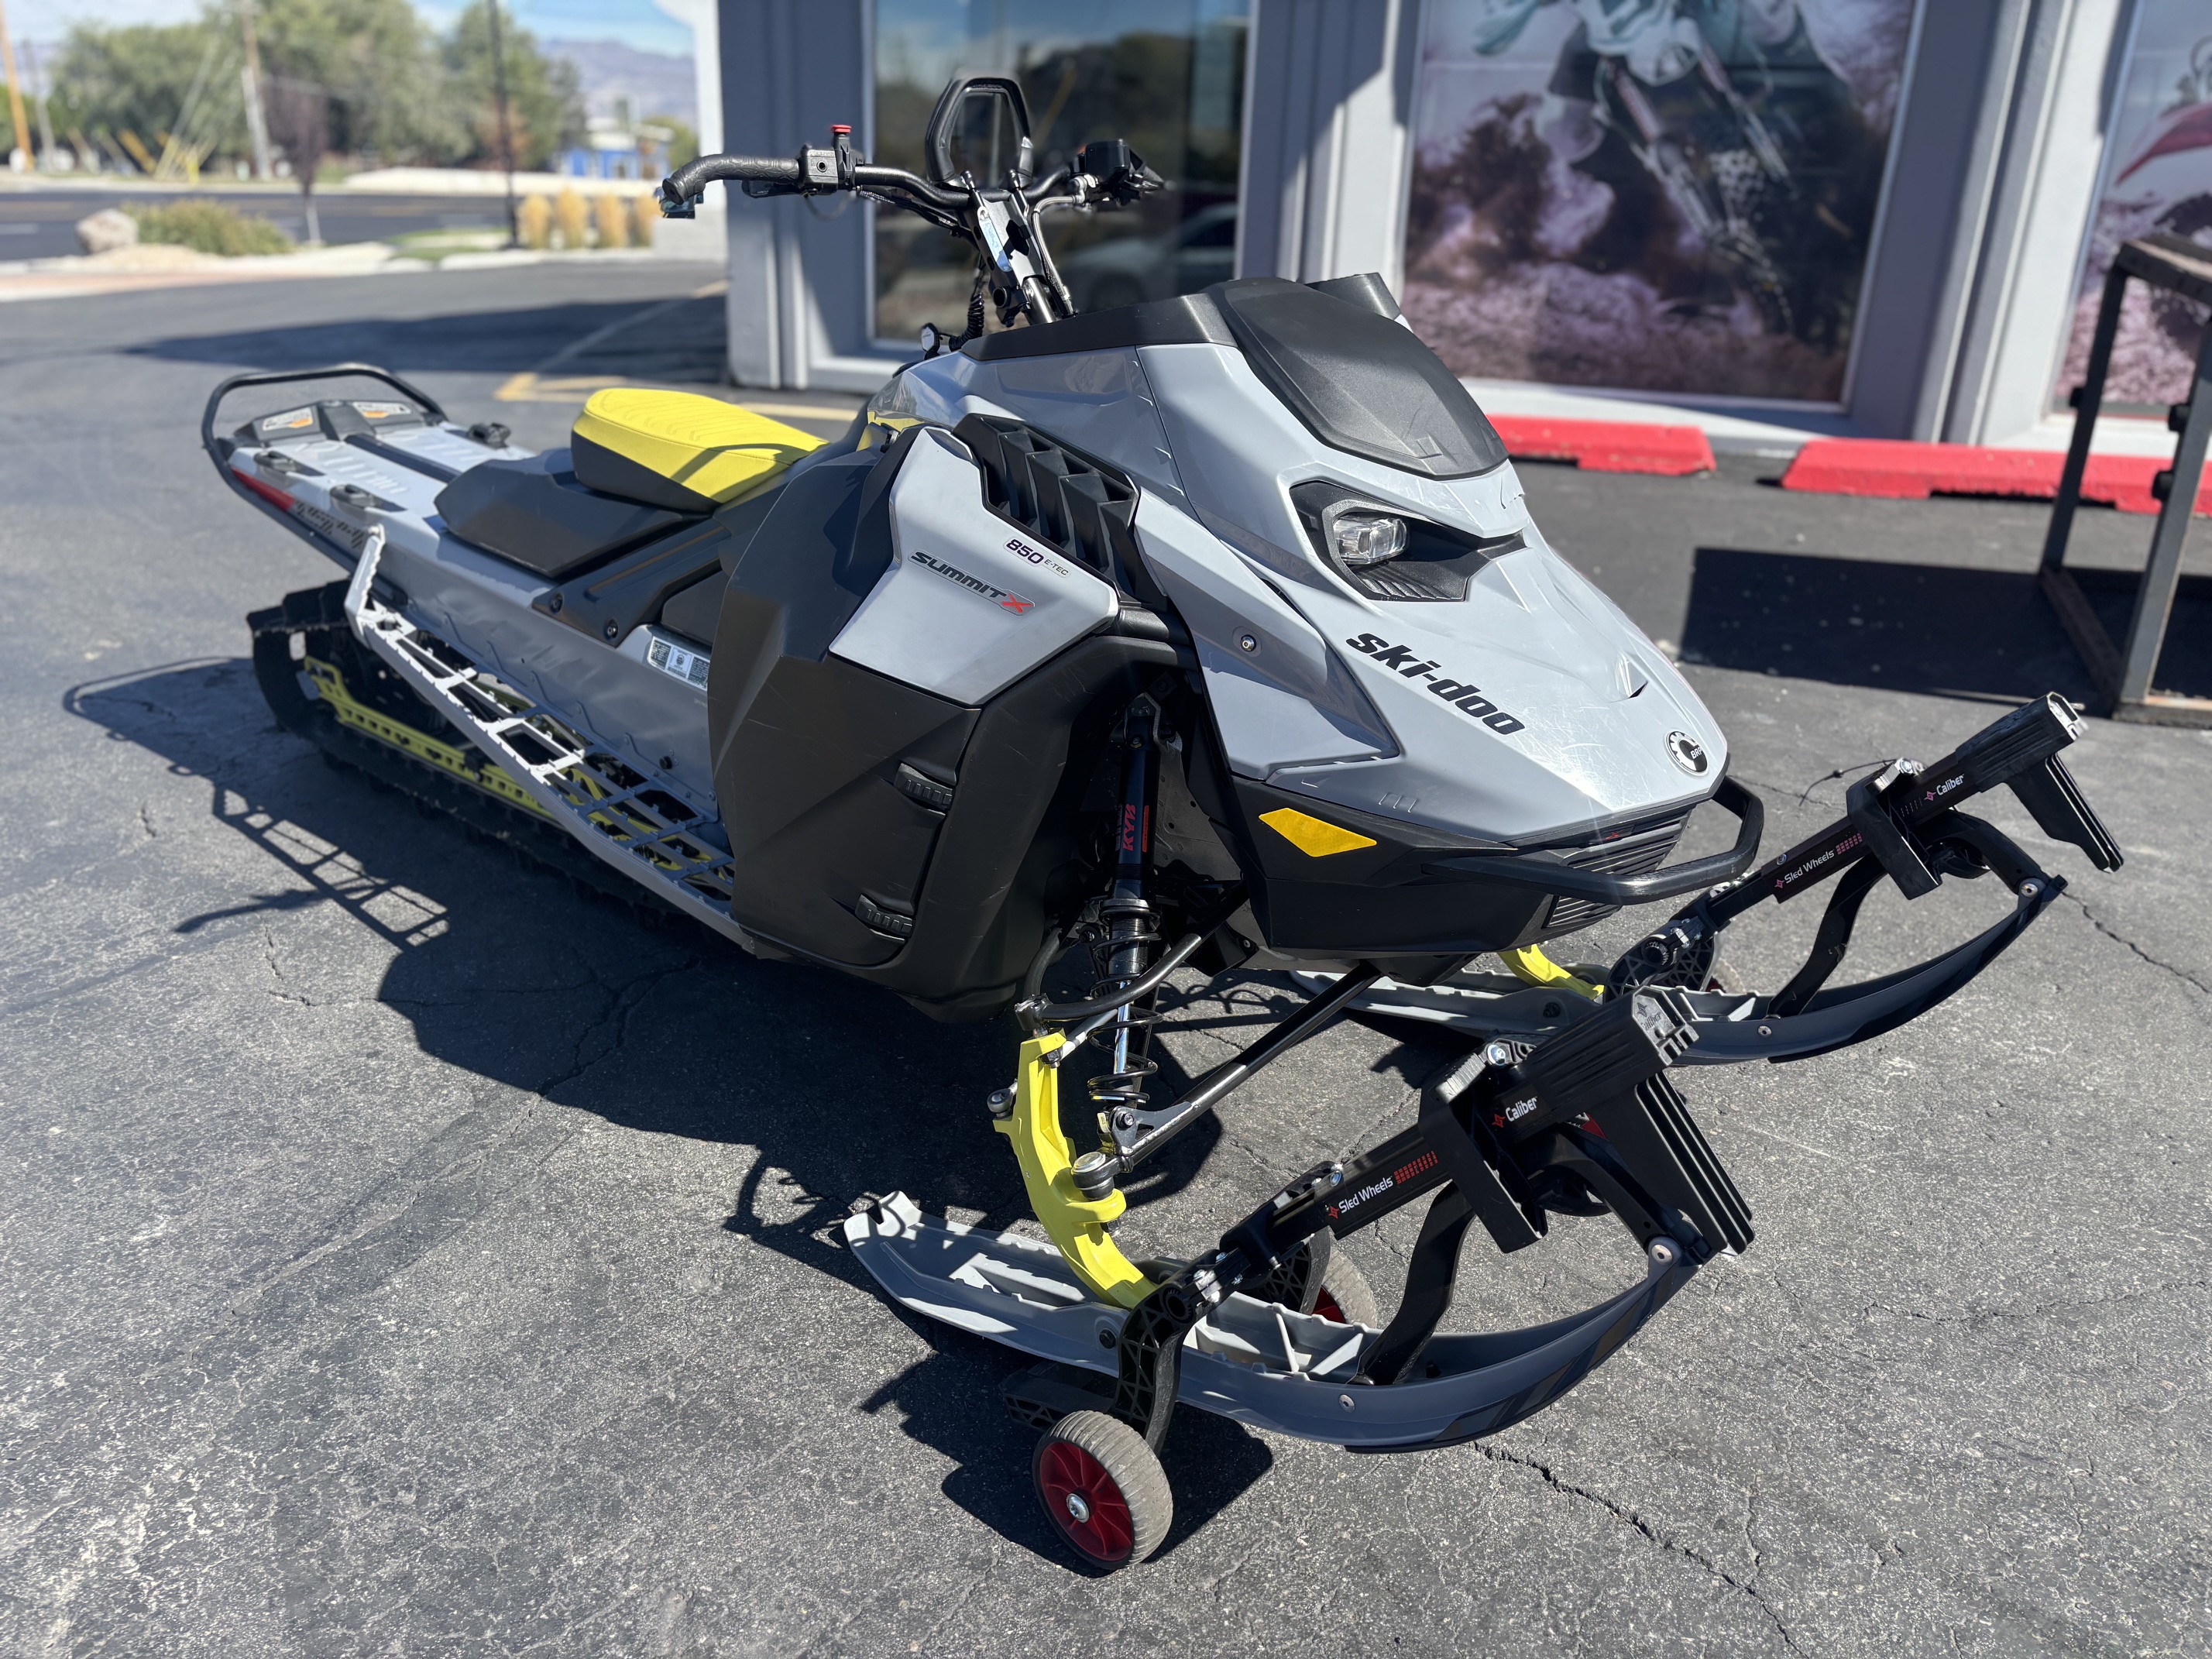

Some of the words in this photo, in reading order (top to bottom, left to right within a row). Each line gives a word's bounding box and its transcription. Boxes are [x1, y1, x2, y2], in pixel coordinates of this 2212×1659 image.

[911, 551, 1007, 598] SUMMIT
[1006, 538, 1044, 565] 850
[1044, 558, 1069, 576] E-TEC
[1345, 633, 1526, 735] ski-doo
[1689, 746, 1703, 760] BRP
[1936, 774, 1964, 796] Caliber
[1122, 803, 1136, 851] KYB
[1784, 867, 1804, 884] Sled
[1802, 850, 1836, 873] Wheels
[1505, 1096, 1538, 1122] Caliber
[1338, 1194, 1360, 1214] Sled
[1358, 1176, 1394, 1202] Wheels
